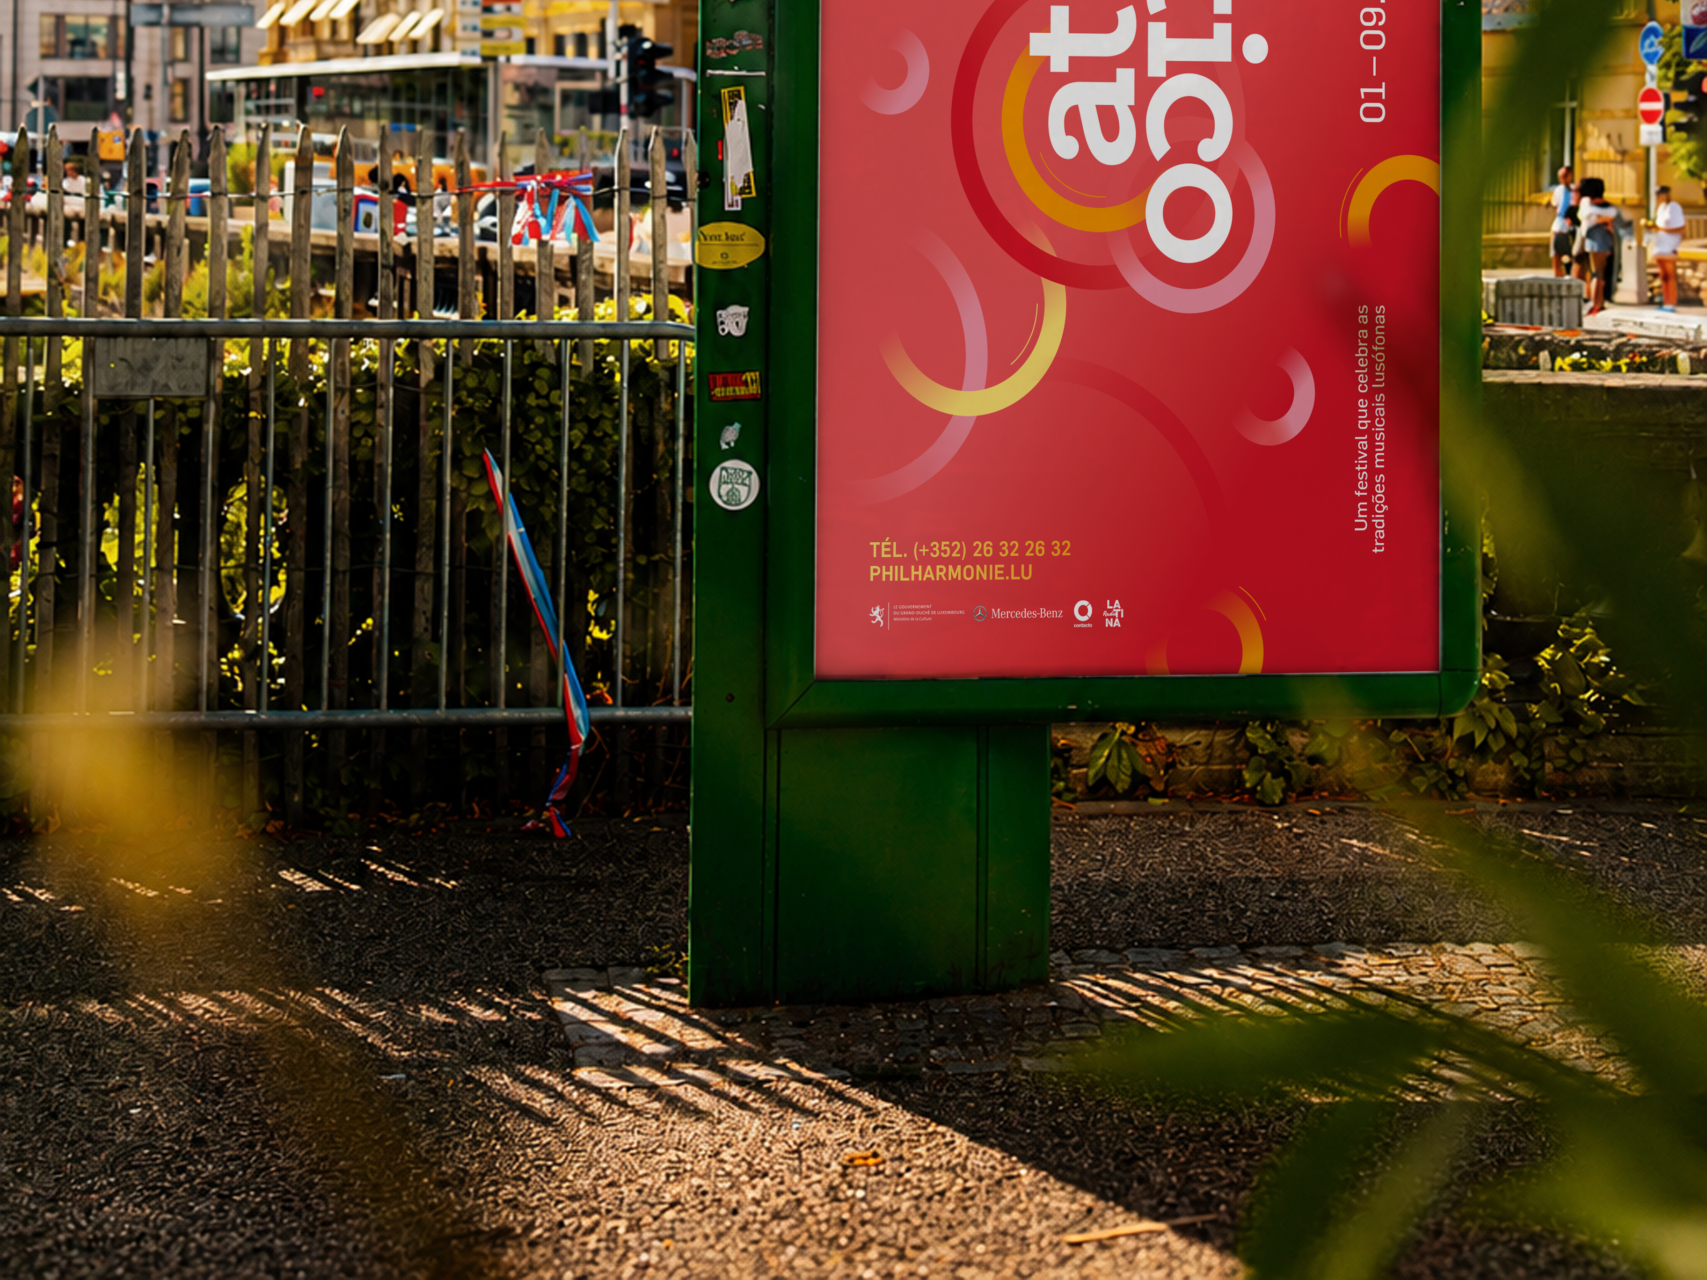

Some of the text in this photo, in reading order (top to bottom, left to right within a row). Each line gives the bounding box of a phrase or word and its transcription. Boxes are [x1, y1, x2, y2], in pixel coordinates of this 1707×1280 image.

[1353, 304, 1372, 532] Um festival que celebra as
[1371, 304, 1389, 554] tradições musicais lusófonas
[869, 536, 1072, 562] TÉL. (+352) 26 32 26 32
[869, 563, 1033, 582] PHILHARMONIE.LU
[991, 607, 1063, 619] Mercedes-Benz
